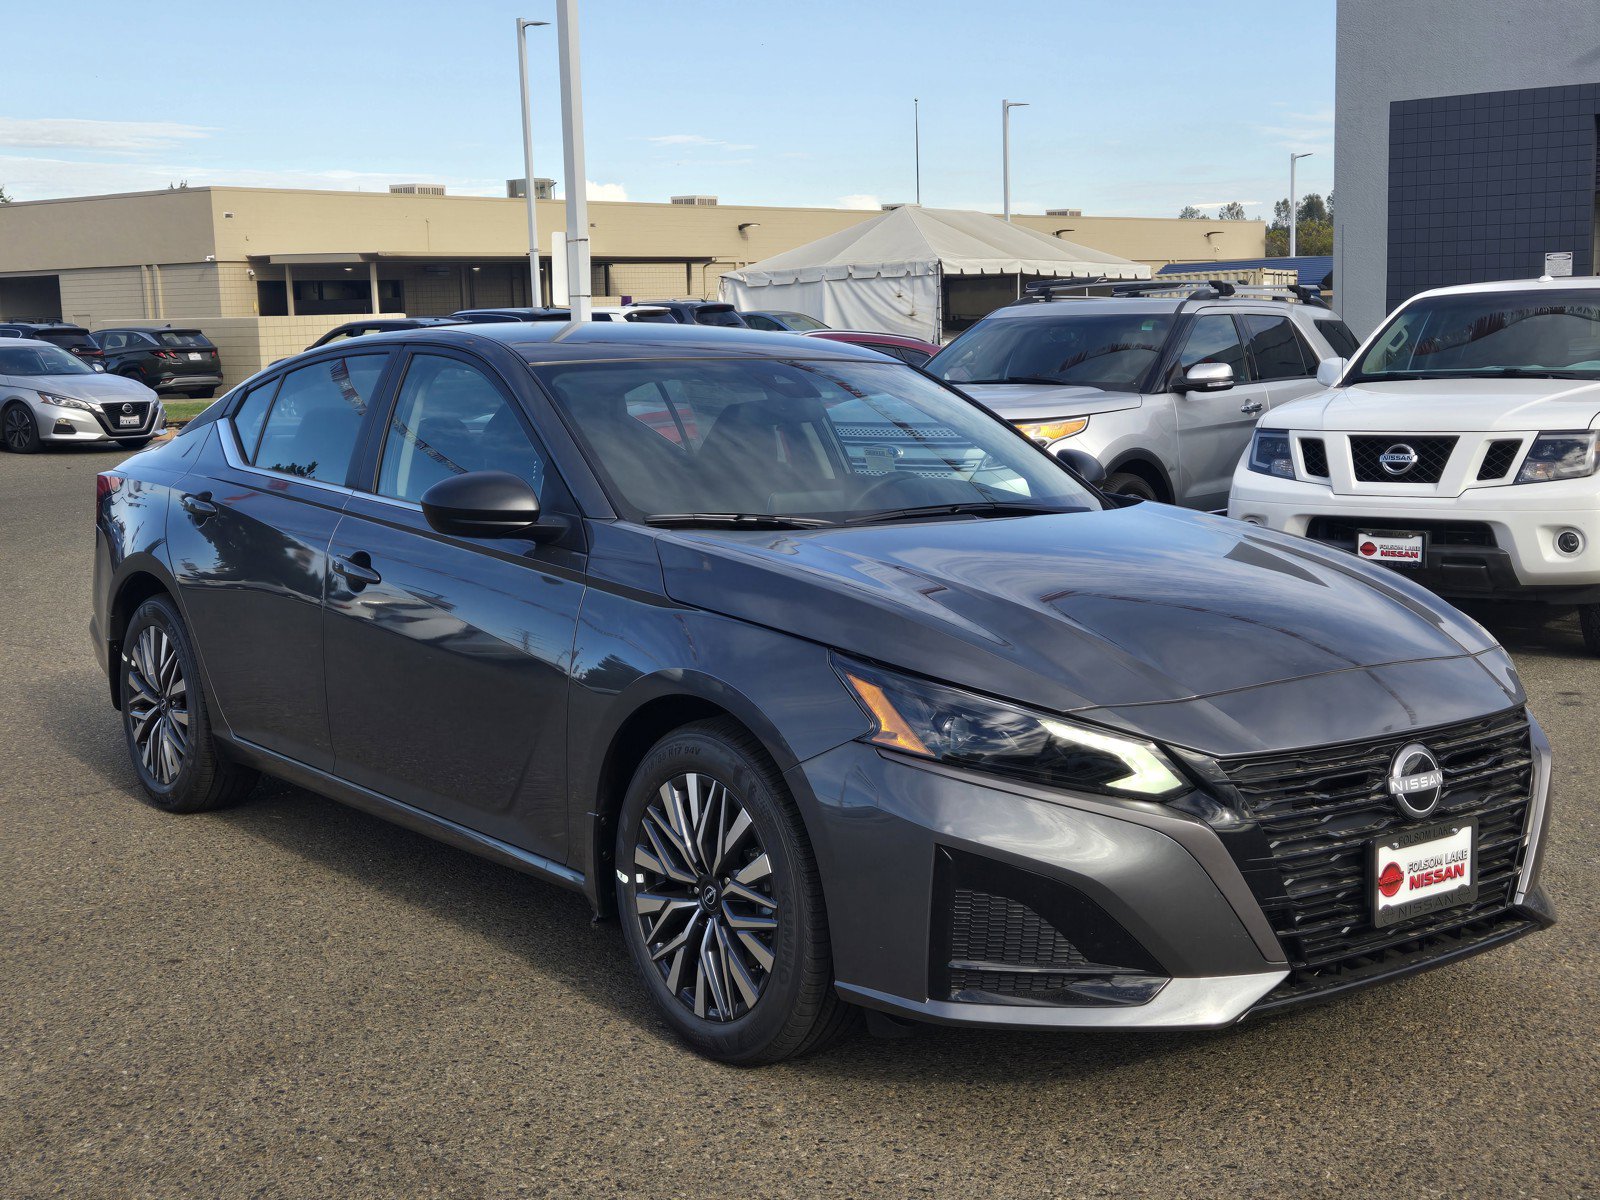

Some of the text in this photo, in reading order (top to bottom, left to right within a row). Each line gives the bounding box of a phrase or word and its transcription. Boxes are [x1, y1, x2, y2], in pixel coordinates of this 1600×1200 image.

[1382, 454, 1413, 462] NISSAN
[1380, 550, 1419, 559] NISSAN
[1391, 772, 1444, 792] NISSAN
[1398, 830, 1432, 847] FOLSOM
[1407, 848, 1468, 874] FOLSOM LAKE
[1409, 862, 1466, 891] NISSAN
[1398, 893, 1454, 919] NISSAN
